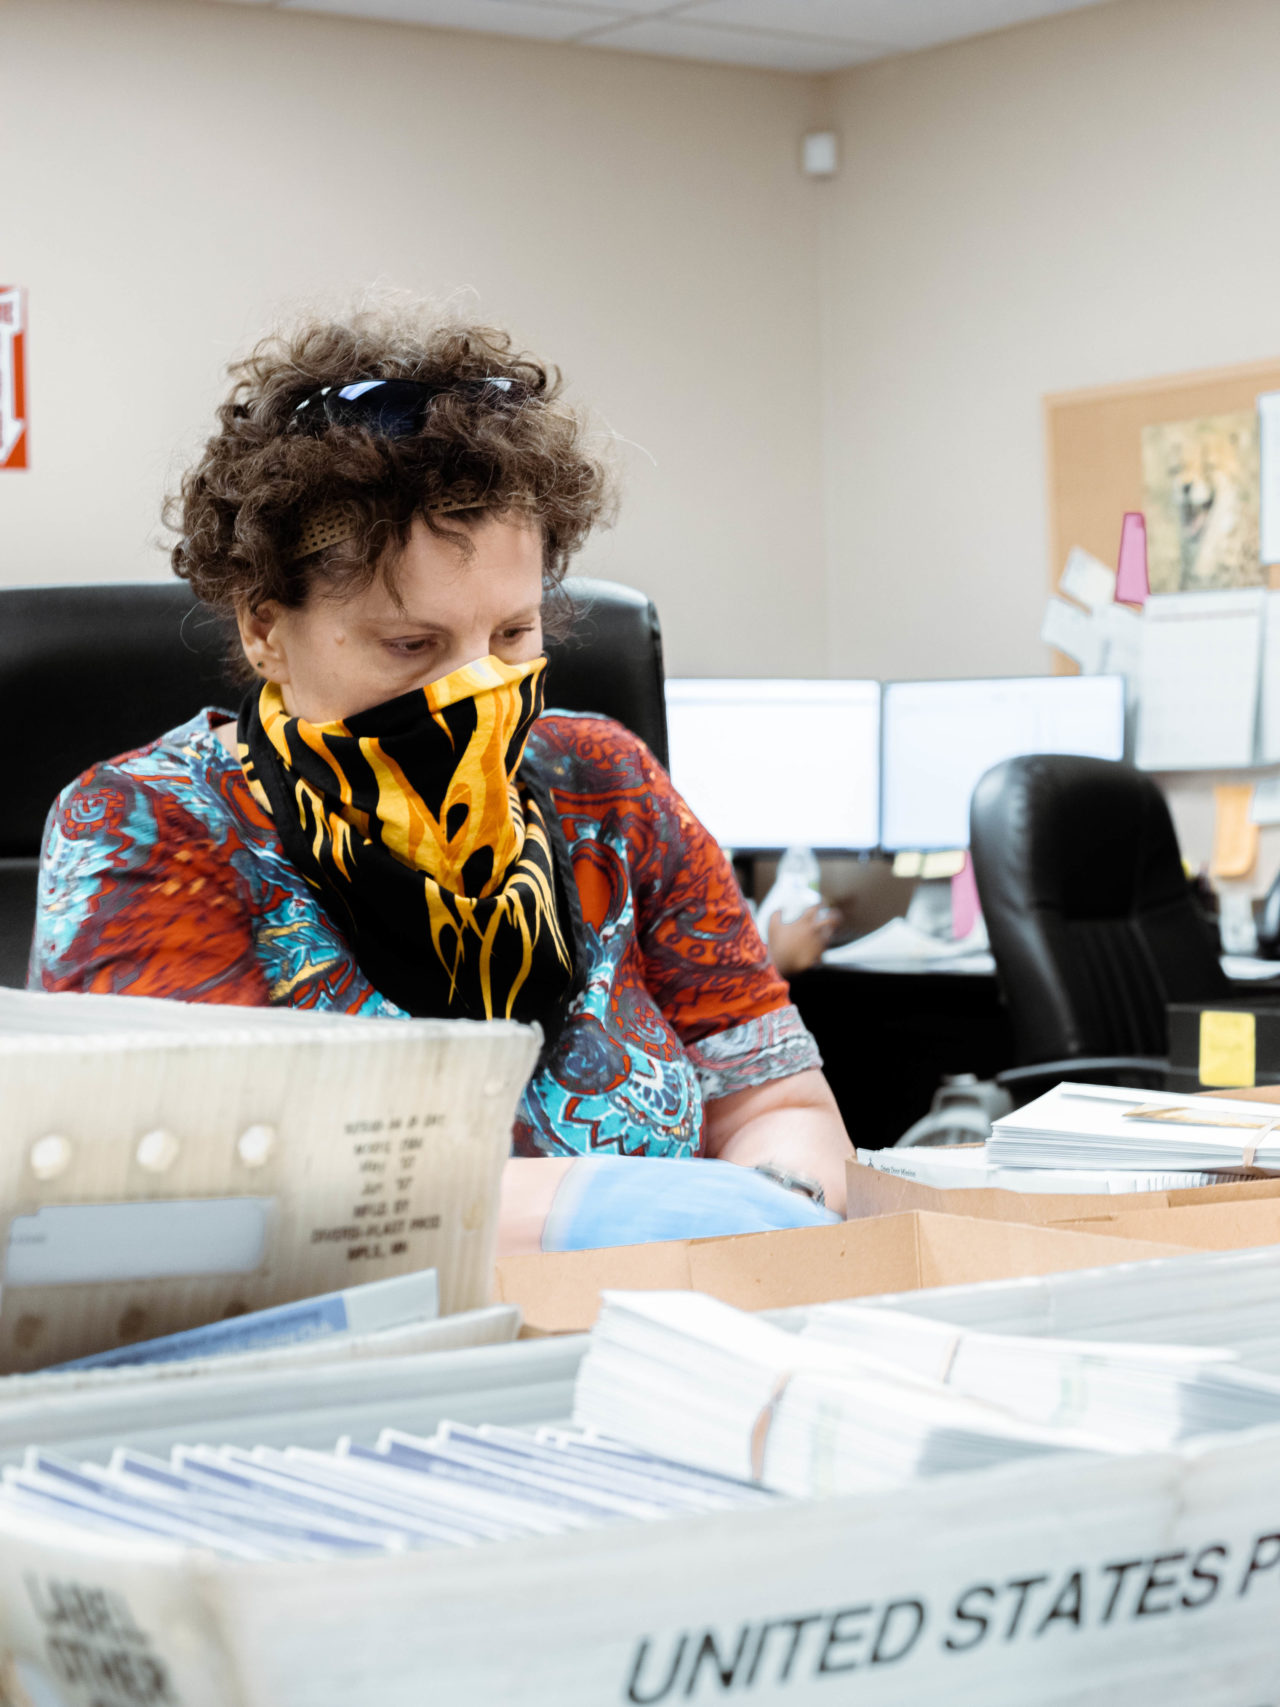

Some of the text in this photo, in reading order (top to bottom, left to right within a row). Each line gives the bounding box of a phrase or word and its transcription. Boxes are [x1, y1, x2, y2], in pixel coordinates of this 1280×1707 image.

[24, 1570, 149, 1647] LABEL
[625, 1597, 926, 1705] UNITED
[942, 1542, 1229, 1656] STATES
